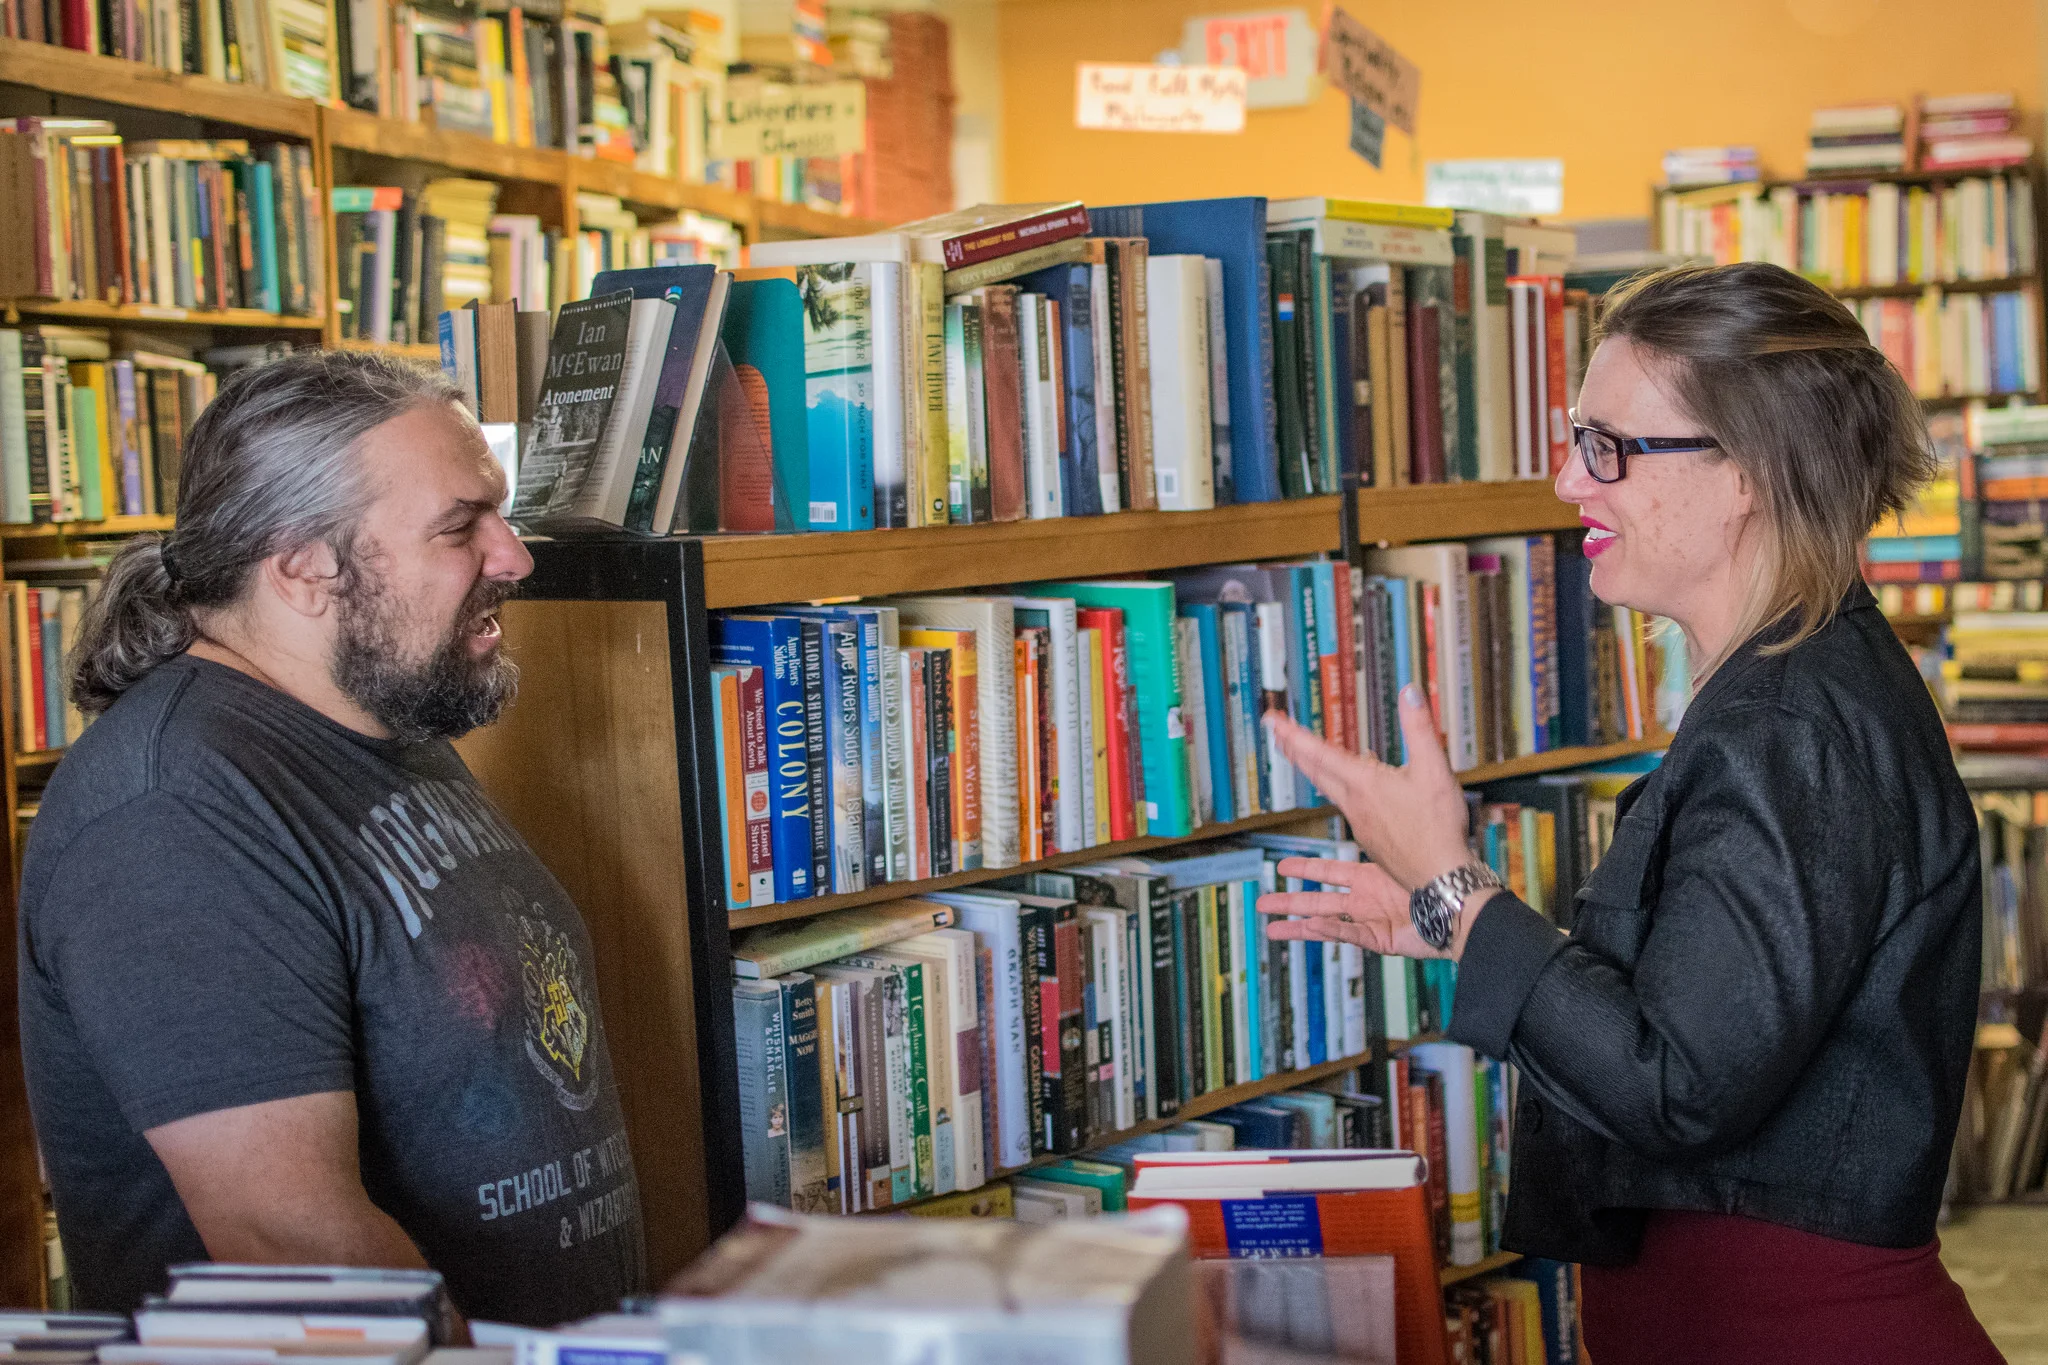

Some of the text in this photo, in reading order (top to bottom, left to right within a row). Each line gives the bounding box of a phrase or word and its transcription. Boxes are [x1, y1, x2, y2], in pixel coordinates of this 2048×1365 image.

[576, 322, 606, 345] Ian
[1135, 254, 1147, 370] RUDYARD KIPLING
[855, 317, 866, 360] SHRIVER
[926, 334, 943, 368] CANE
[541, 384, 614, 407] Atonement
[926, 372, 943, 412] RIVER
[857, 382, 868, 490] SO MUCH FOR THAT
[1303, 587, 1317, 672] SOME LUCK
[774, 645, 785, 679] Siddons
[787, 636, 801, 686] Anne Rivers
[866, 649, 879, 682] Rivers
[1328, 663, 1341, 697] JANE
[805, 641, 823, 753] LIONEL SHRIVER
[840, 631, 861, 786] Anne Rivers Siddons
[883, 646, 901, 770] ANNE RIVERS SIDDONS
[933, 656, 944, 749] IRON & RUST
[746, 710, 757, 769] About Kevin
[754, 689, 767, 764] We Need to Talk
[776, 701, 810, 820] COLONY
[812, 768, 825, 851] THE NEW REPUBLIC
[889, 778, 906, 846] FAULT LINES
[964, 765, 978, 821] World
[750, 825, 760, 865] Shriver
[760, 823, 771, 858] Lionel
[847, 798, 863, 851] Islands
[1026, 926, 1038, 982] WILBUR
[792, 1007, 815, 1020] Smith
[795, 997, 813, 1009] Betty
[1029, 985, 1041, 1037] SMITH
[1118, 968, 1127, 1007] DEATH
[772, 1011, 783, 1071] WHISKEY
[797, 1043, 815, 1056] NOW
[911, 1004, 923, 1057] Capture
[1010, 1018, 1021, 1054] MAN
[765, 1028, 777, 1094] & CHARLIE
[914, 1062, 924, 1077] the
[915, 1077, 928, 1119] Castle
[1031, 1044, 1043, 1133] GOLDEN LION
[478, 1148, 591, 1221] SCHOOL OF
[560, 1216, 573, 1248] &
[1240, 1247, 1311, 1256] POWER
